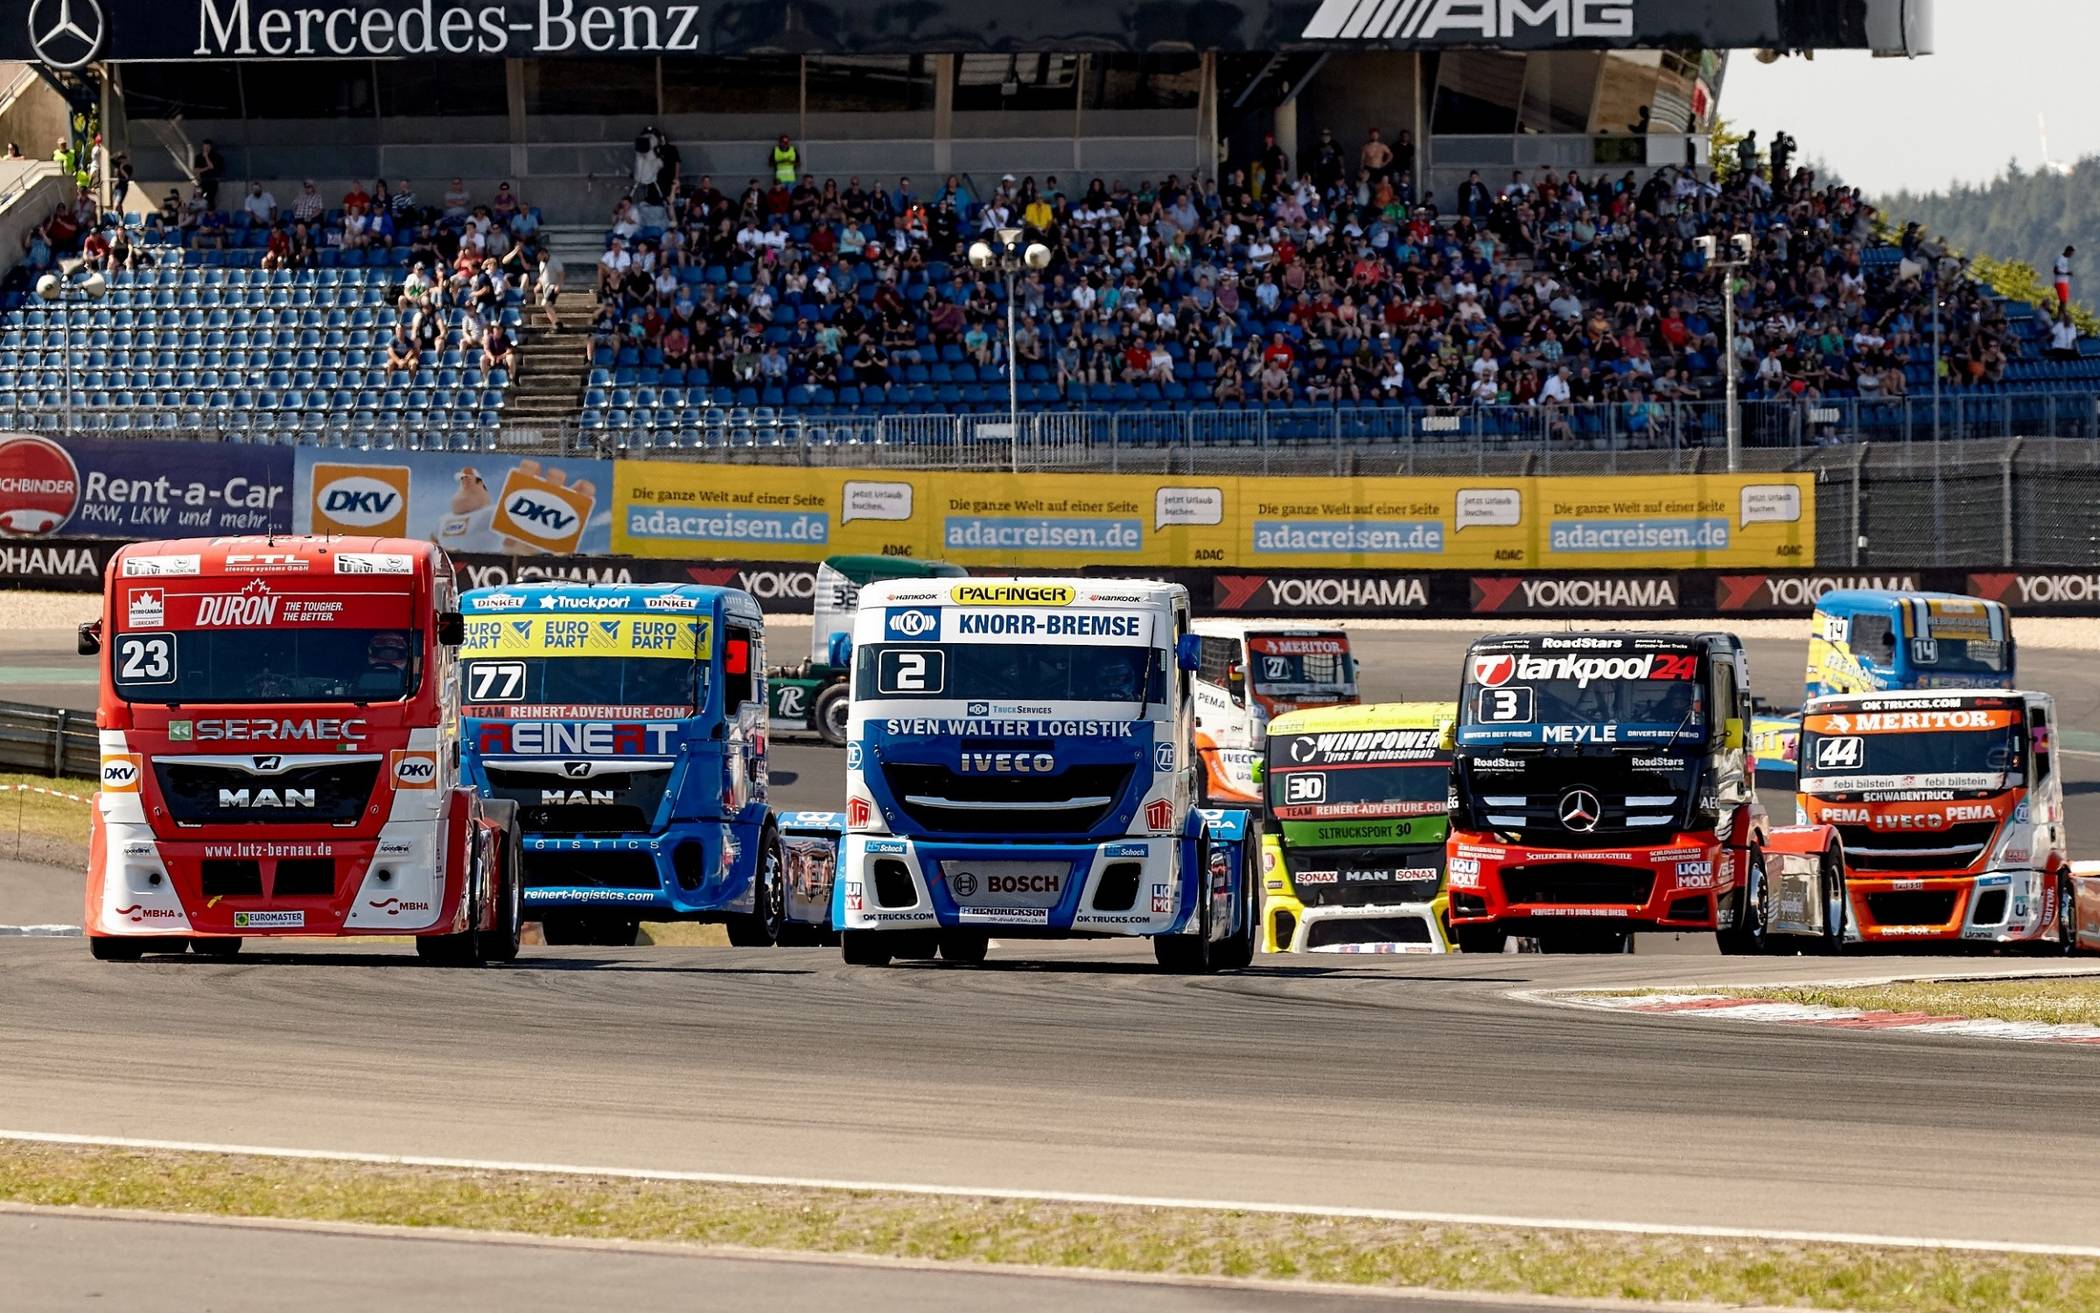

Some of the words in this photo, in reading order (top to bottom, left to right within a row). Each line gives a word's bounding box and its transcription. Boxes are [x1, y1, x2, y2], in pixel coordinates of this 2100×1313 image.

[1416, 0, 1634, 38] AMG
[193, 0, 700, 55] Mercedes-Benz
[0, 477, 75, 494] CHBINDER
[84, 471, 284, 509] Rent-a-Car
[325, 489, 397, 514] DKV
[632, 487, 654, 499] Die
[657, 490, 696, 503] ganze
[699, 490, 729, 503] Welt
[732, 492, 753, 503] auf
[756, 493, 790, 505] einer
[793, 494, 825, 506] Seite
[509, 495, 576, 531] DKV
[950, 499, 971, 510] Die
[973, 500, 1011, 513] ganze
[1014, 500, 1043, 512] Welt
[1047, 500, 1068, 512] auf
[1071, 500, 1103, 512] einer
[1107, 501, 1139, 513] Seite
[1258, 503, 1279, 515] Die
[1281, 505, 1319, 517] ganze
[1322, 503, 1351, 515] Welt
[1353, 503, 1373, 515] auf
[1376, 503, 1407, 515] einer
[1410, 503, 1440, 515] Seite
[1553, 502, 1574, 514] Die
[1575, 504, 1610, 516] ganze
[1613, 502, 1641, 514] Welt
[1643, 501, 1662, 514] auf
[1665, 501, 1695, 513] einer
[1697, 500, 1725, 512] Seite
[80, 503, 124, 526] PKW,
[130, 505, 171, 525] LKW
[178, 507, 211, 526] und
[631, 510, 825, 540] adacreisen.de
[949, 521, 1139, 547] adacreisen.de
[1258, 524, 1441, 550] adacreisen.de
[1554, 522, 1726, 549] adacreisen.de
[881, 544, 912, 556] ADAC
[1195, 549, 1224, 560] ADAC
[1494, 549, 1524, 561] ADAC
[1776, 545, 1803, 556] ADAC
[0, 548, 99, 577] HAMA
[959, 586, 1067, 602] PALFINGER
[1267, 578, 1427, 608] YOKOHAMA
[1521, 576, 1676, 607] YOKOHAMA
[285, 602, 301, 611] THE
[303, 602, 344, 611] TOUGHER.
[477, 599, 521, 607] DINKEL
[557, 595, 631, 610] Truckport
[649, 598, 694, 608] DINKEL
[196, 595, 278, 626] DURON
[283, 612, 299, 621] THE
[301, 612, 334, 621] BETTER.
[544, 620, 590, 635] EURO
[632, 621, 677, 636] EURO
[959, 614, 1140, 637] KNORR-BREMSE
[1829, 622, 1844, 639] 14
[544, 635, 589, 648] PART
[631, 636, 677, 649] PART
[1542, 637, 1623, 649] RoadStars
[1915, 641, 1936, 659] 14
[122, 639, 169, 678] 23
[897, 653, 926, 690] 2
[1266, 657, 1284, 678] 27
[1517, 653, 1698, 688] tankpool24
[472, 665, 523, 698] 77
[1197, 692, 1226, 709] PEMA
[1493, 690, 1518, 720] 3
[1861, 700, 1882, 711] OK
[1884, 699, 1961, 710] TRUCKS.COM
[470, 706, 505, 718] TEAM
[510, 706, 685, 719] REINERT-ADVENTURE.COM
[886, 718, 942, 736] SVEN
[946, 719, 1030, 737] WALTER
[1038, 720, 1133, 738] LOGISTIK
[1855, 711, 1996, 731] MERITOR.
[196, 718, 368, 742] SERMEC
[1542, 725, 1618, 743] MEYLE
[1324, 751, 1346, 764] Tyres
[1351, 750, 1365, 761] for
[1367, 748, 1437, 763] professionals
[1820, 738, 1858, 766] 44
[961, 753, 1055, 772] IVECO
[1473, 757, 1525, 767] RoadStars
[1631, 757, 1684, 767] RoadStars
[104, 766, 136, 780] DKV
[400, 763, 433, 777] DKV
[1290, 777, 1323, 799] 30
[1834, 780, 1854, 789] febi
[1856, 779, 1895, 788] bilstein
[1925, 778, 1945, 787] febi
[1947, 777, 1988, 786] bilstein
[219, 788, 316, 808] MAN
[541, 789, 614, 805] MAN
[1863, 790, 1954, 802] SCHWABENTRUCK
[1286, 806, 1313, 817] TEAM
[1821, 808, 1871, 823] PEMA
[1945, 804, 1996, 821] PEMA
[1876, 813, 1943, 829] IVECO
[1396, 823, 1412, 836] 30
[204, 842, 333, 857] www.lutz-bernau.de
[1121, 847, 1145, 857] Schoch
[1346, 871, 1389, 881] MAN
[1397, 870, 1435, 880] SONAX
[1678, 863, 1712, 876] LIQUI
[987, 875, 1060, 892] BOSCH
[1296, 873, 1337, 883] SONAX
[1678, 875, 1712, 888] MOLY
[524, 888, 654, 902] reinert-logistics.com
[142, 909, 176, 918] MBHA
[400, 902, 430, 911] MBHA
[972, 907, 1046, 917] HENDRICKSON
[249, 913, 303, 922] EUROMASTER
[863, 913, 877, 921] OK
[877, 912, 934, 921] TRUCKS.COM
[1077, 915, 1091, 923] OK
[1092, 915, 1150, 924] TRUCKS.COM
